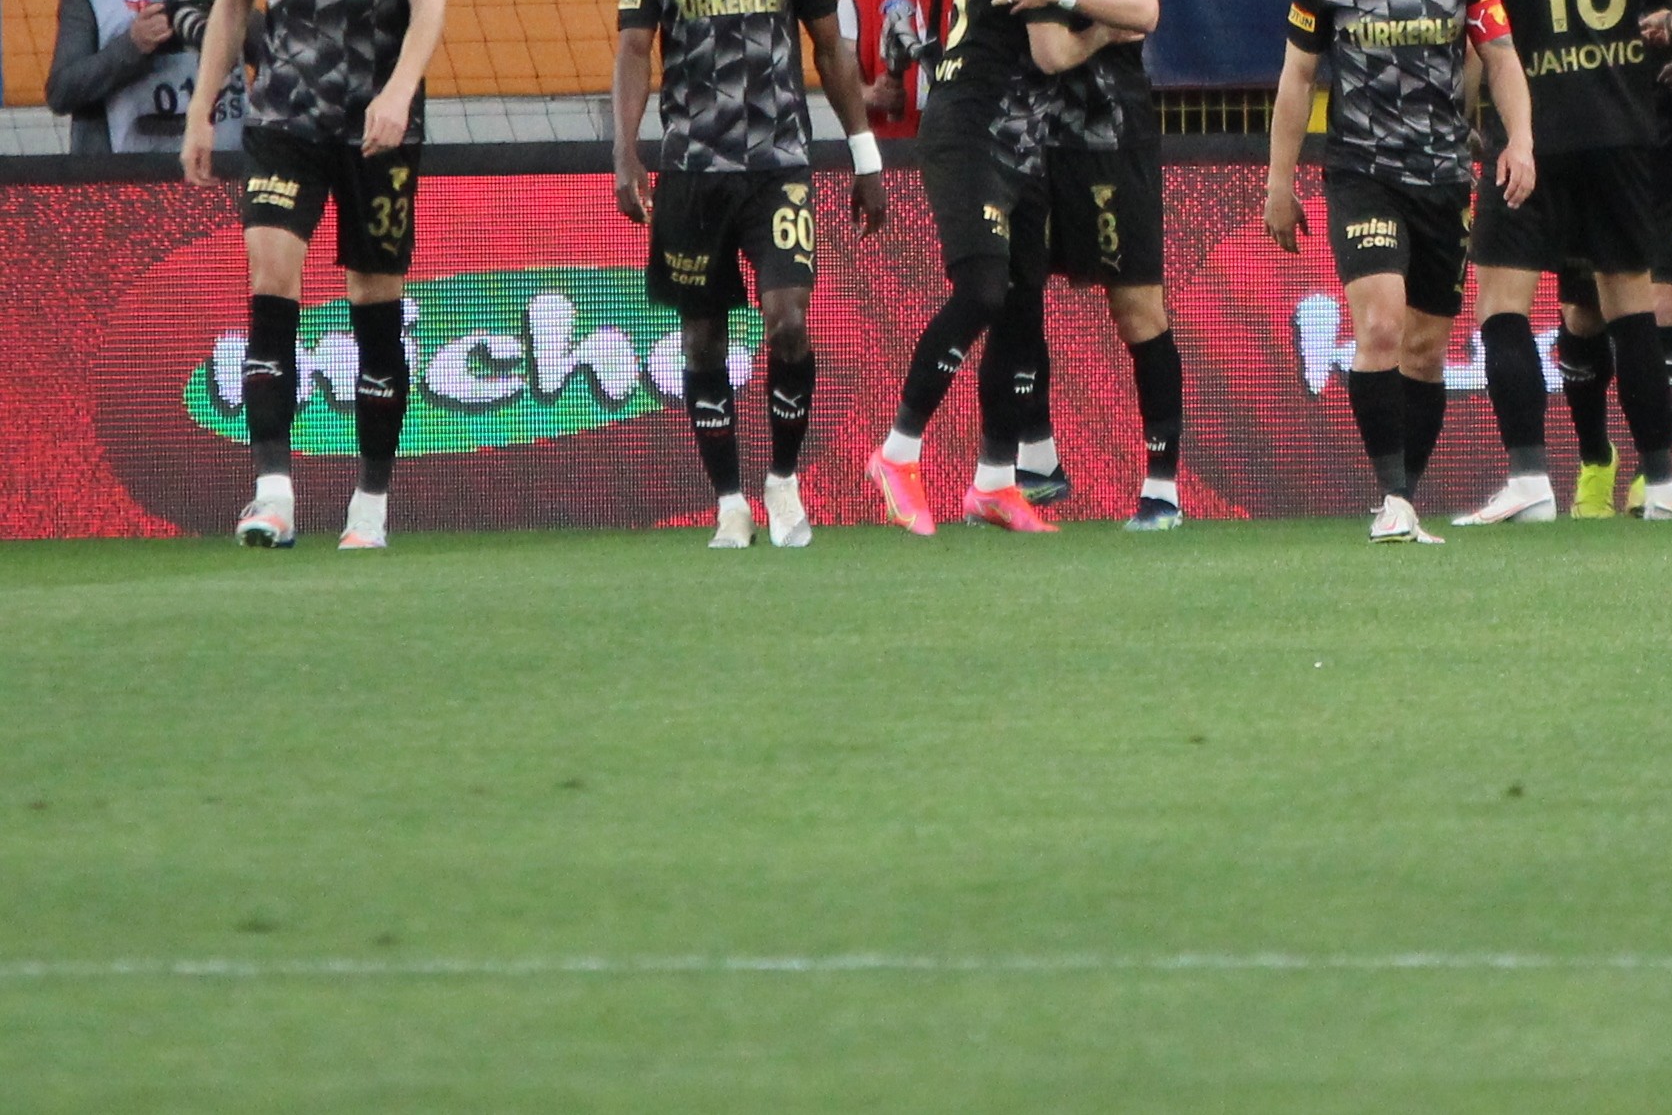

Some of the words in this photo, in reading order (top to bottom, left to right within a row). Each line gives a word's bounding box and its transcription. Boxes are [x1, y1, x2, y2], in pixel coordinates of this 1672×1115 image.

[368, 195, 409, 238] 33
[772, 206, 815, 253] 60
[1345, 218, 1398, 240] misli
